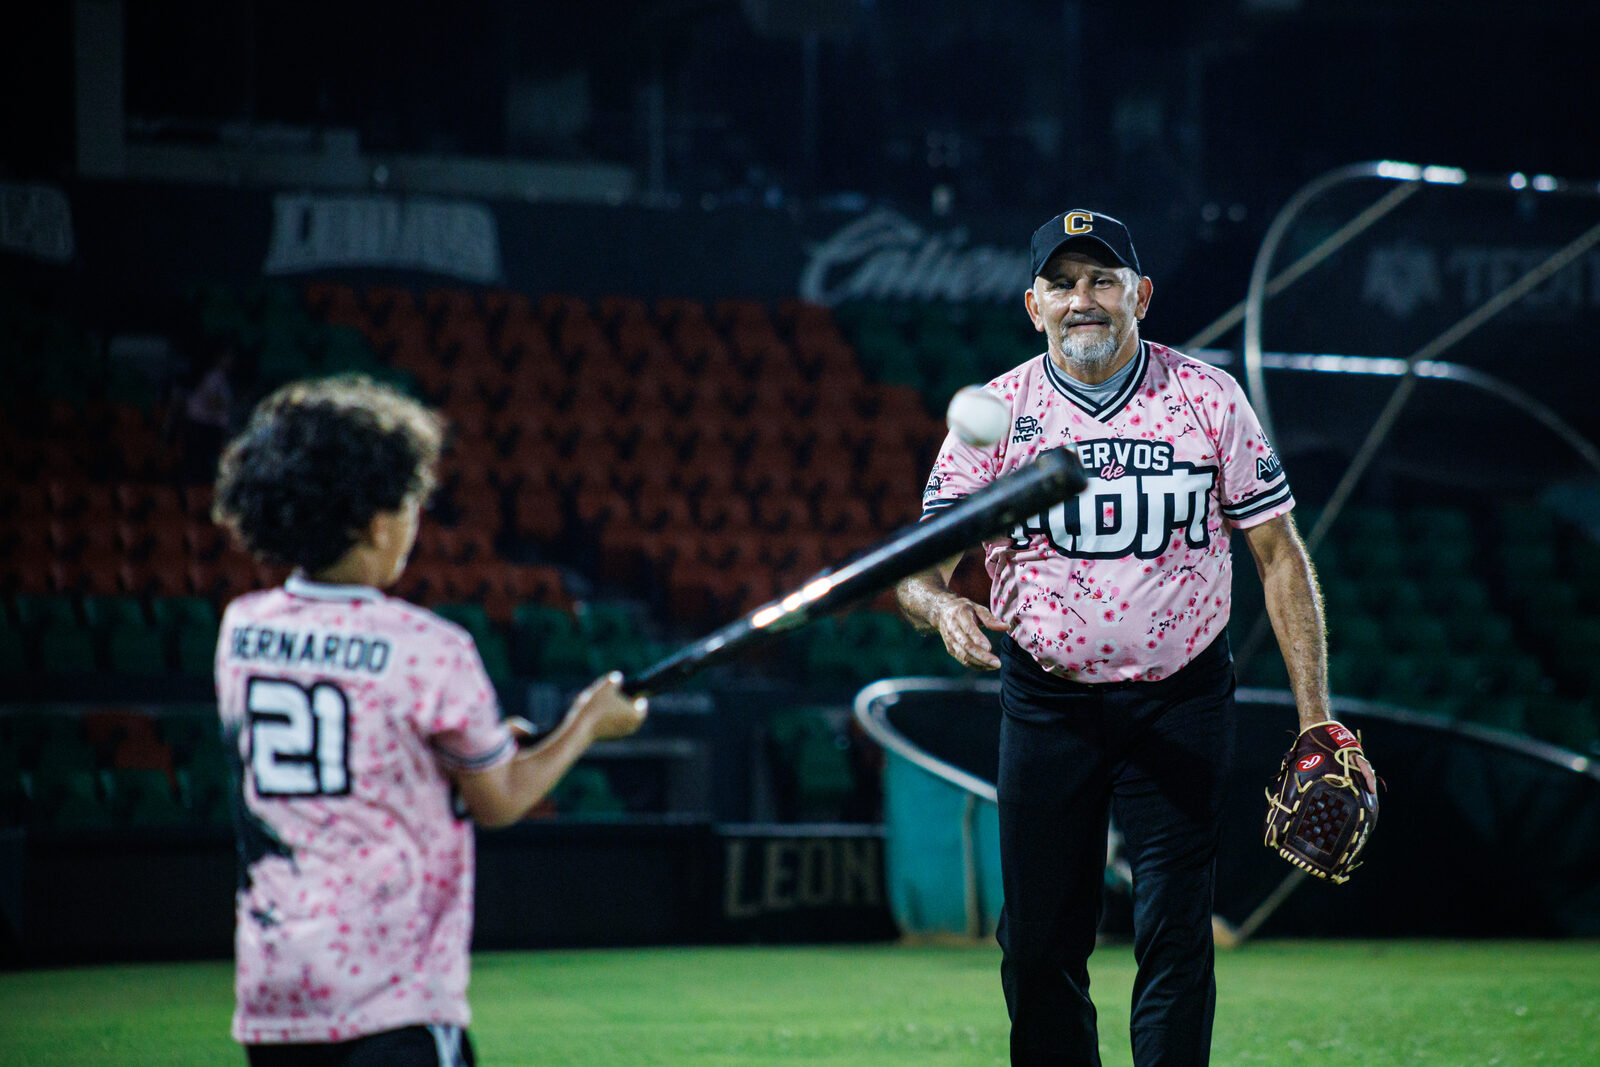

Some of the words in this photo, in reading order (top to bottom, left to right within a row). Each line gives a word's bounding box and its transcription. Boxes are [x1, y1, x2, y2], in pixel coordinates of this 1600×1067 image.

[1064, 211, 1093, 235] C
[1100, 459, 1126, 480] de
[247, 676, 350, 797] 21
